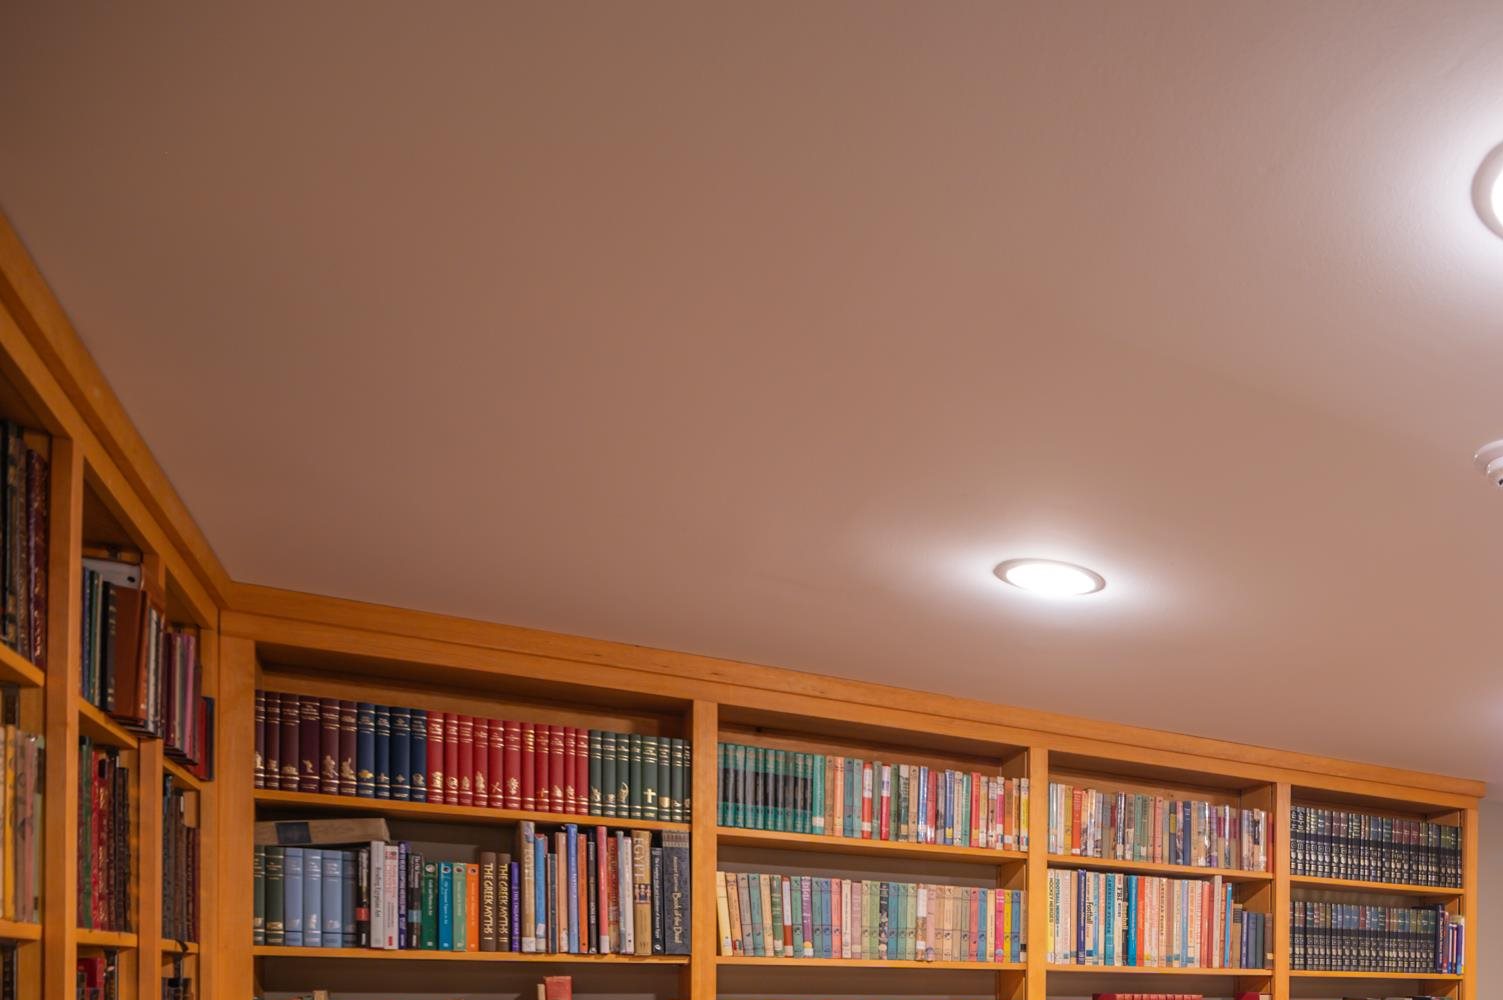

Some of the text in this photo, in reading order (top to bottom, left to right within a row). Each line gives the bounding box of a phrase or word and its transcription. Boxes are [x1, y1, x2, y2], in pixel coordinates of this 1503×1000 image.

[633, 837, 644, 877] EGYPT
[484, 863, 494, 880] THE
[499, 864, 508, 879] THE
[484, 880, 494, 904] GREEK
[499, 881, 508, 905] GREEK
[673, 892, 681, 909] Book
[484, 905, 494, 934] MYTHS
[500, 906, 508, 934] MYTHS
[674, 927, 682, 944] Dead
